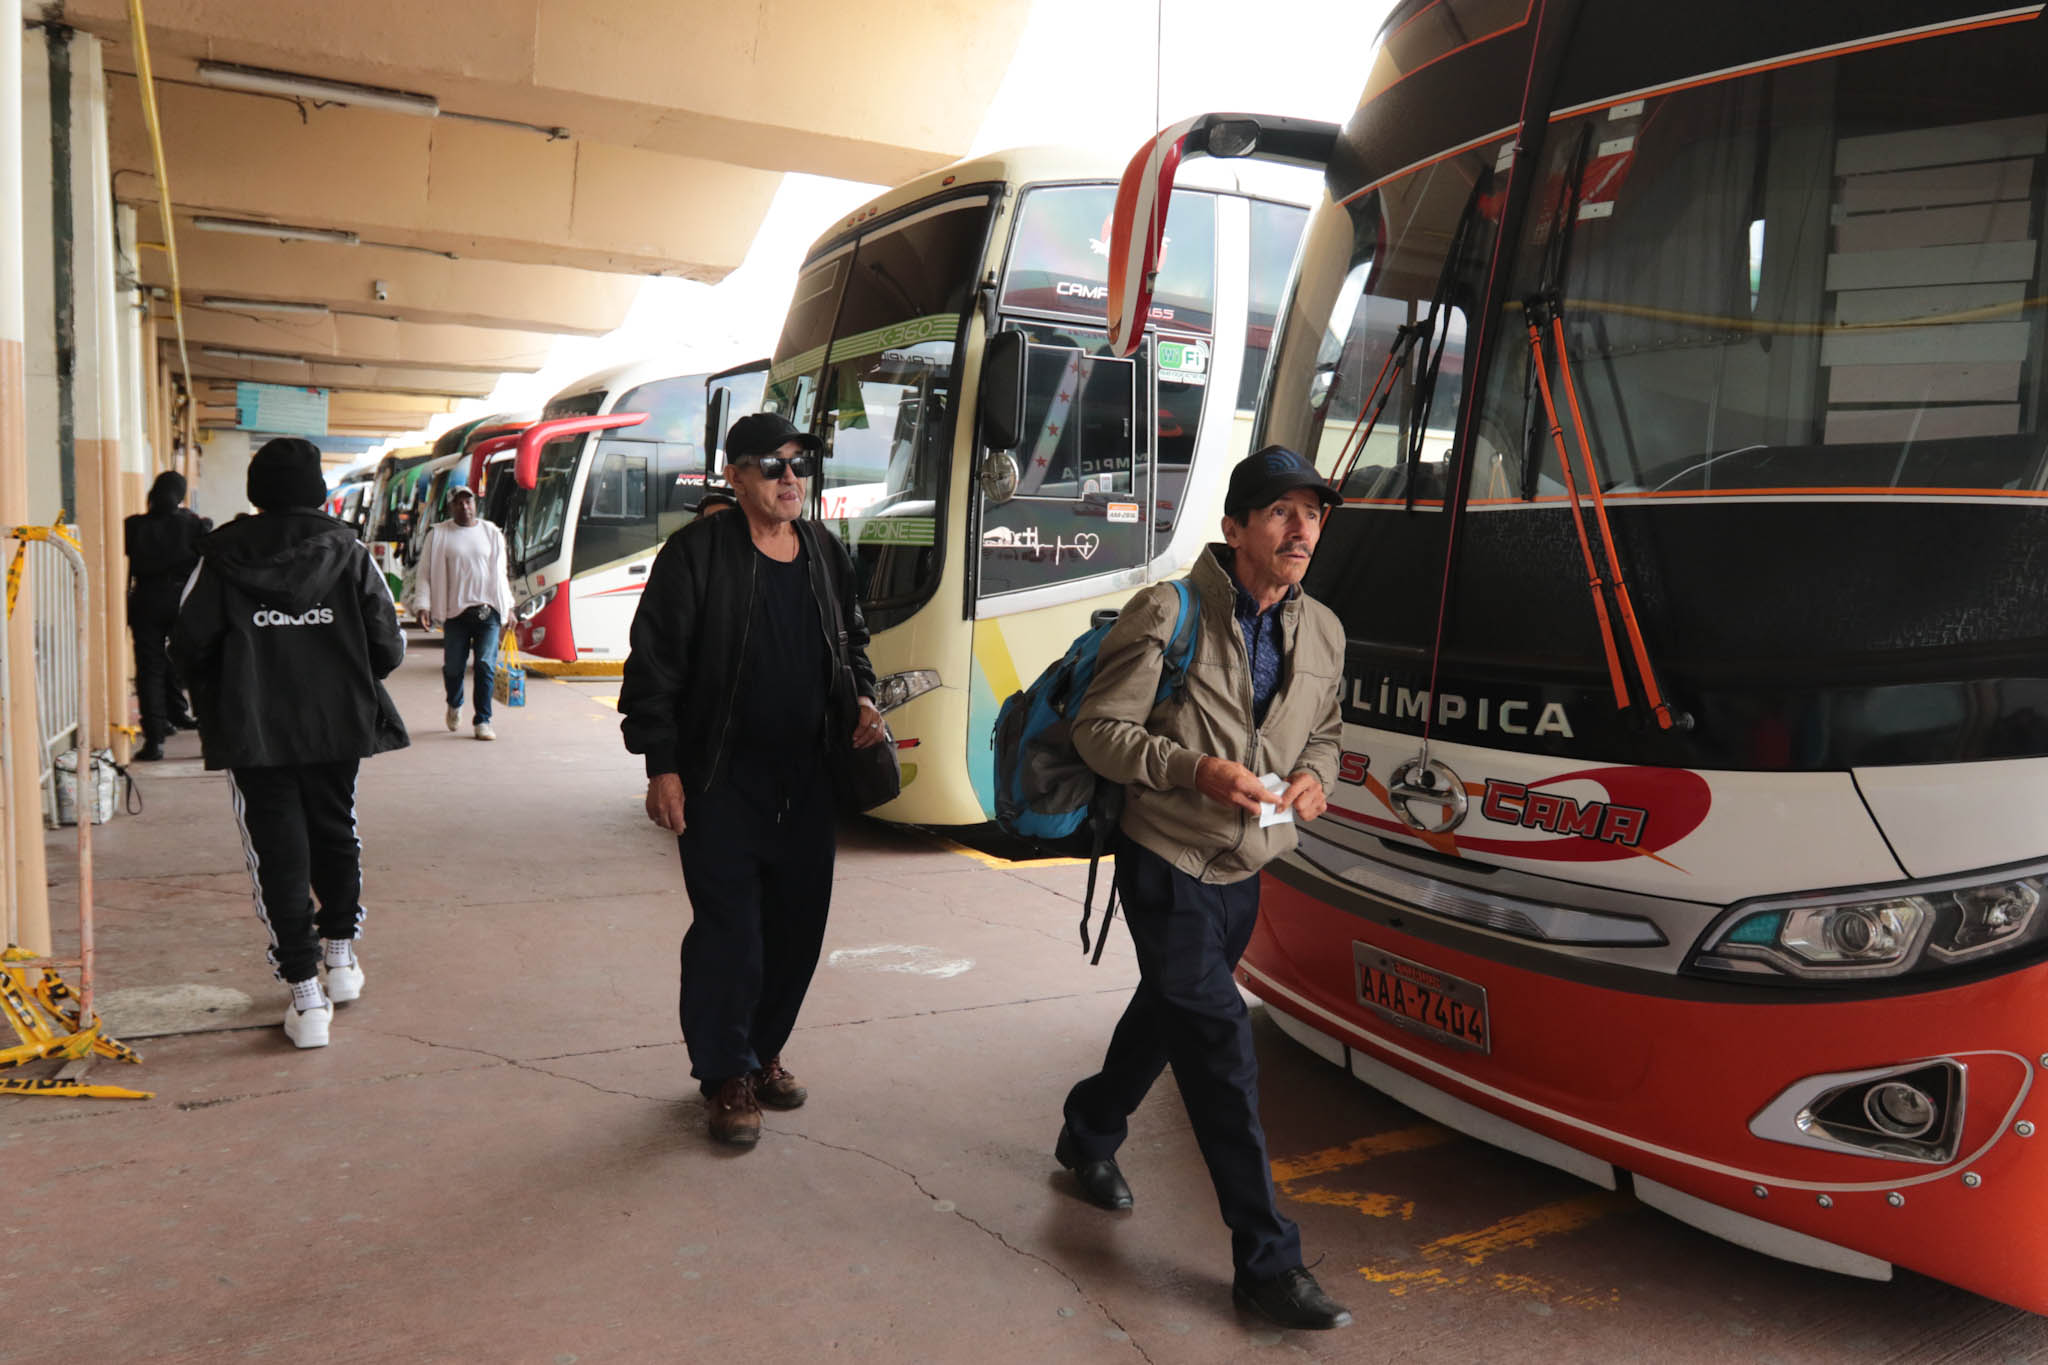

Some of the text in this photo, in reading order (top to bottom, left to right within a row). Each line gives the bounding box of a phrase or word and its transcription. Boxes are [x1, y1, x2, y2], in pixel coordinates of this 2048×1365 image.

[878, 321, 933, 346] K-360
[1481, 777, 1648, 847] CAMA
[1361, 966, 1482, 1044] AAA-7404
